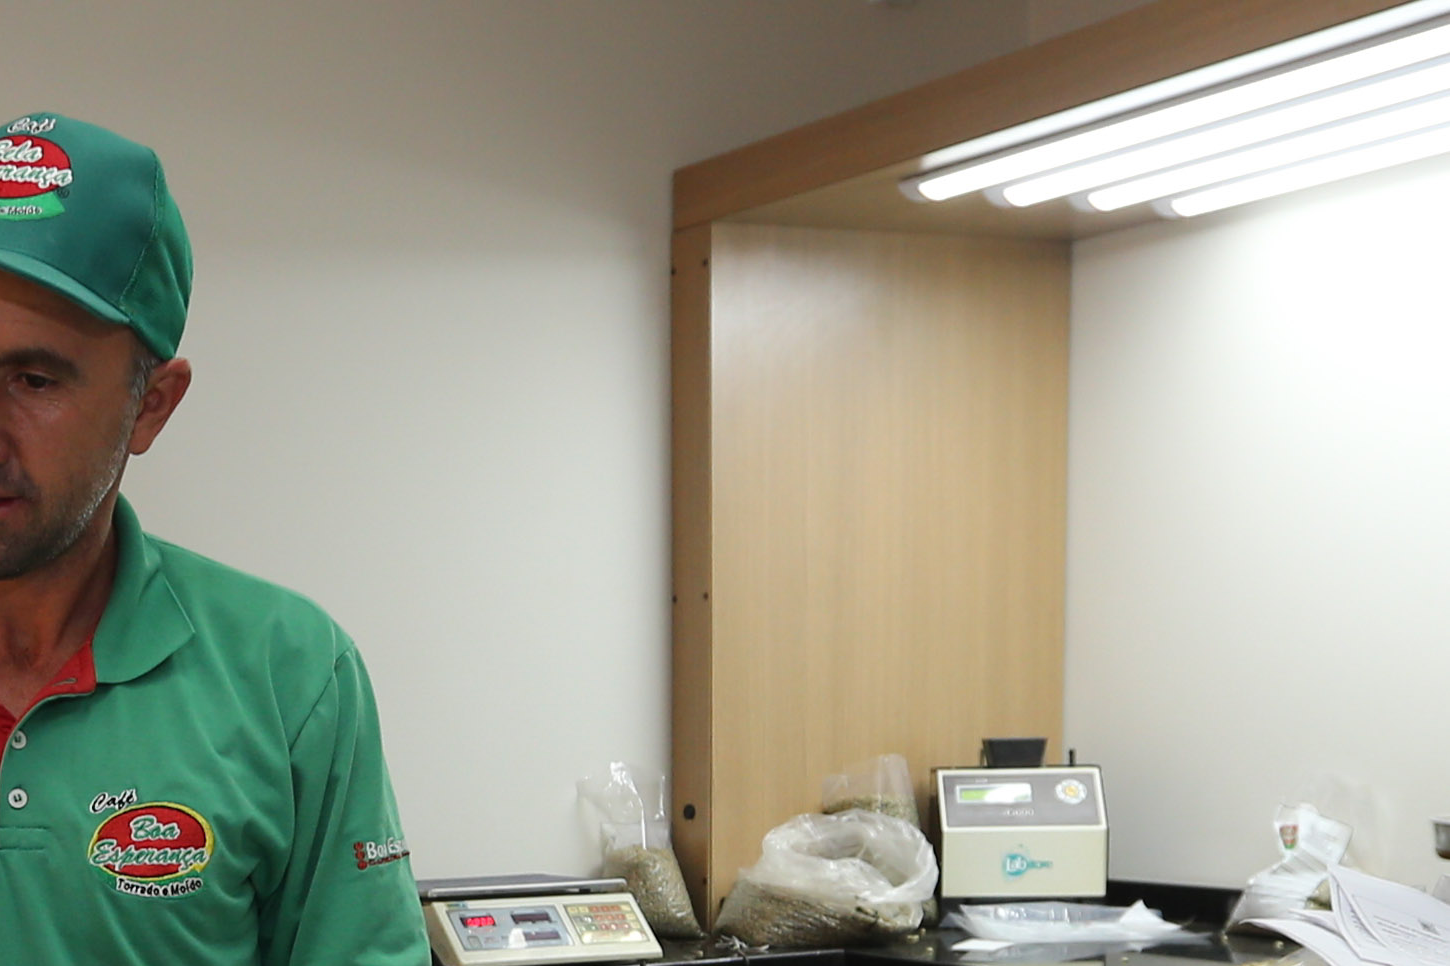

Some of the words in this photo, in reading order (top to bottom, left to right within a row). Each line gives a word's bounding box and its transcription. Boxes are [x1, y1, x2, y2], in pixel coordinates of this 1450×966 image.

[90, 789, 137, 813] Café
[130, 815, 179, 840] Boa
[91, 841, 208, 872] Esperança
[117, 878, 160, 896] Torrado
[162, 886, 170, 896] e
[170, 879, 202, 896] Moído
